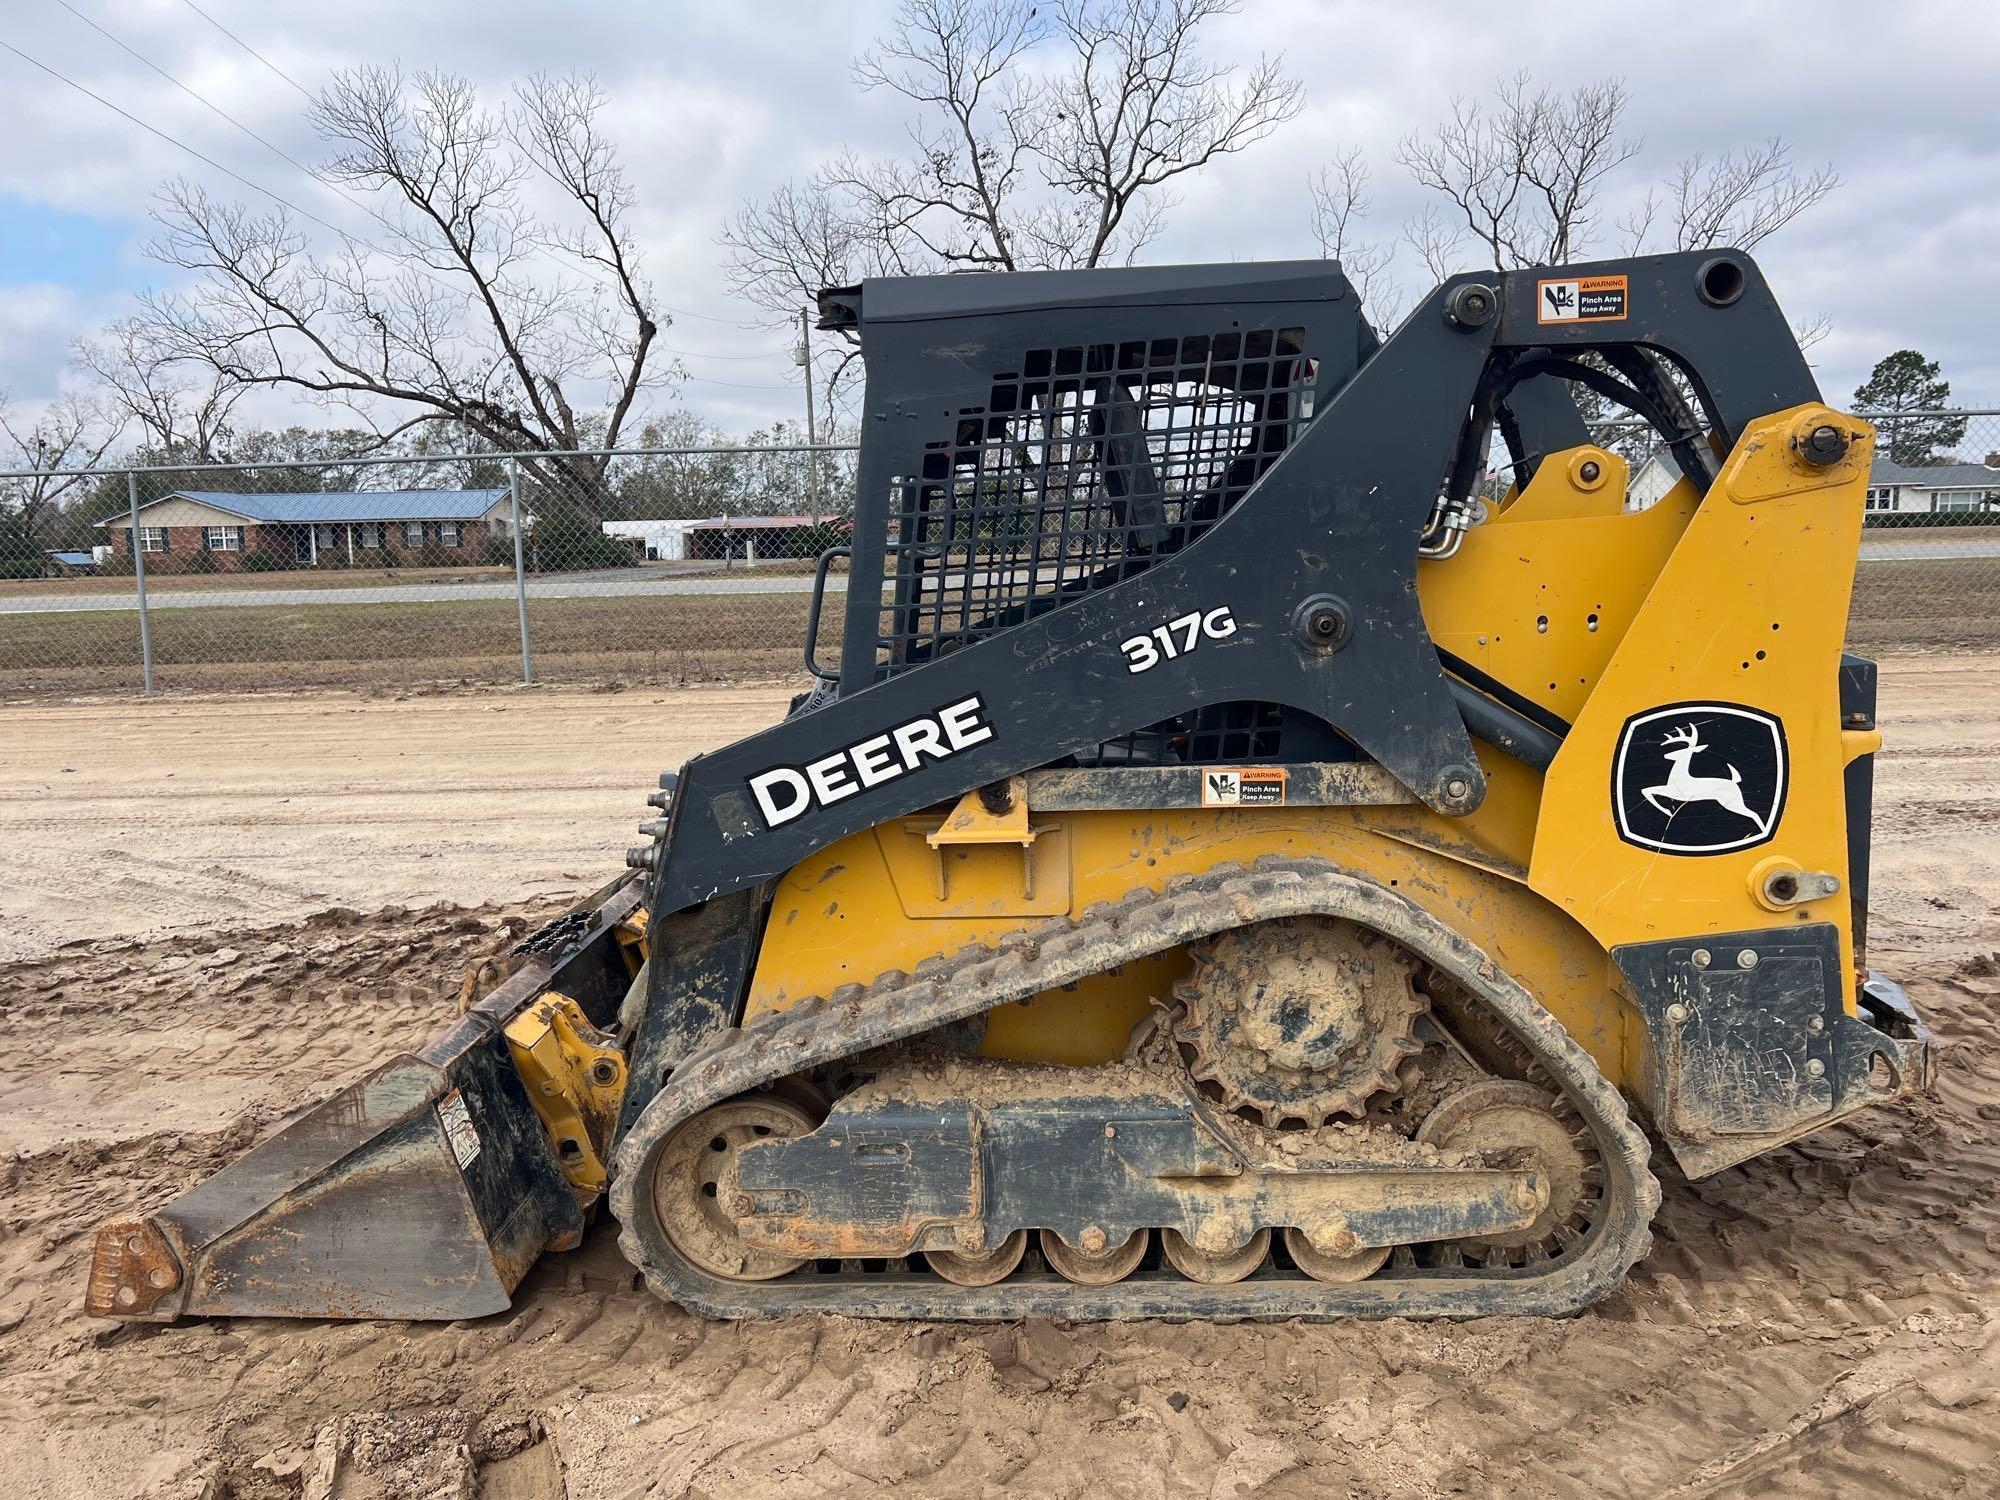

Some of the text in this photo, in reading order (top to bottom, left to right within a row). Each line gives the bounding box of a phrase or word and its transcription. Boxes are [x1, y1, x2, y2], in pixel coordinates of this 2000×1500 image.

[1581, 295, 1622, 304] Pinch Area
[1589, 279, 1623, 288] WARNING
[1120, 606, 1238, 673] 317G
[749, 697, 993, 827] DEERE
